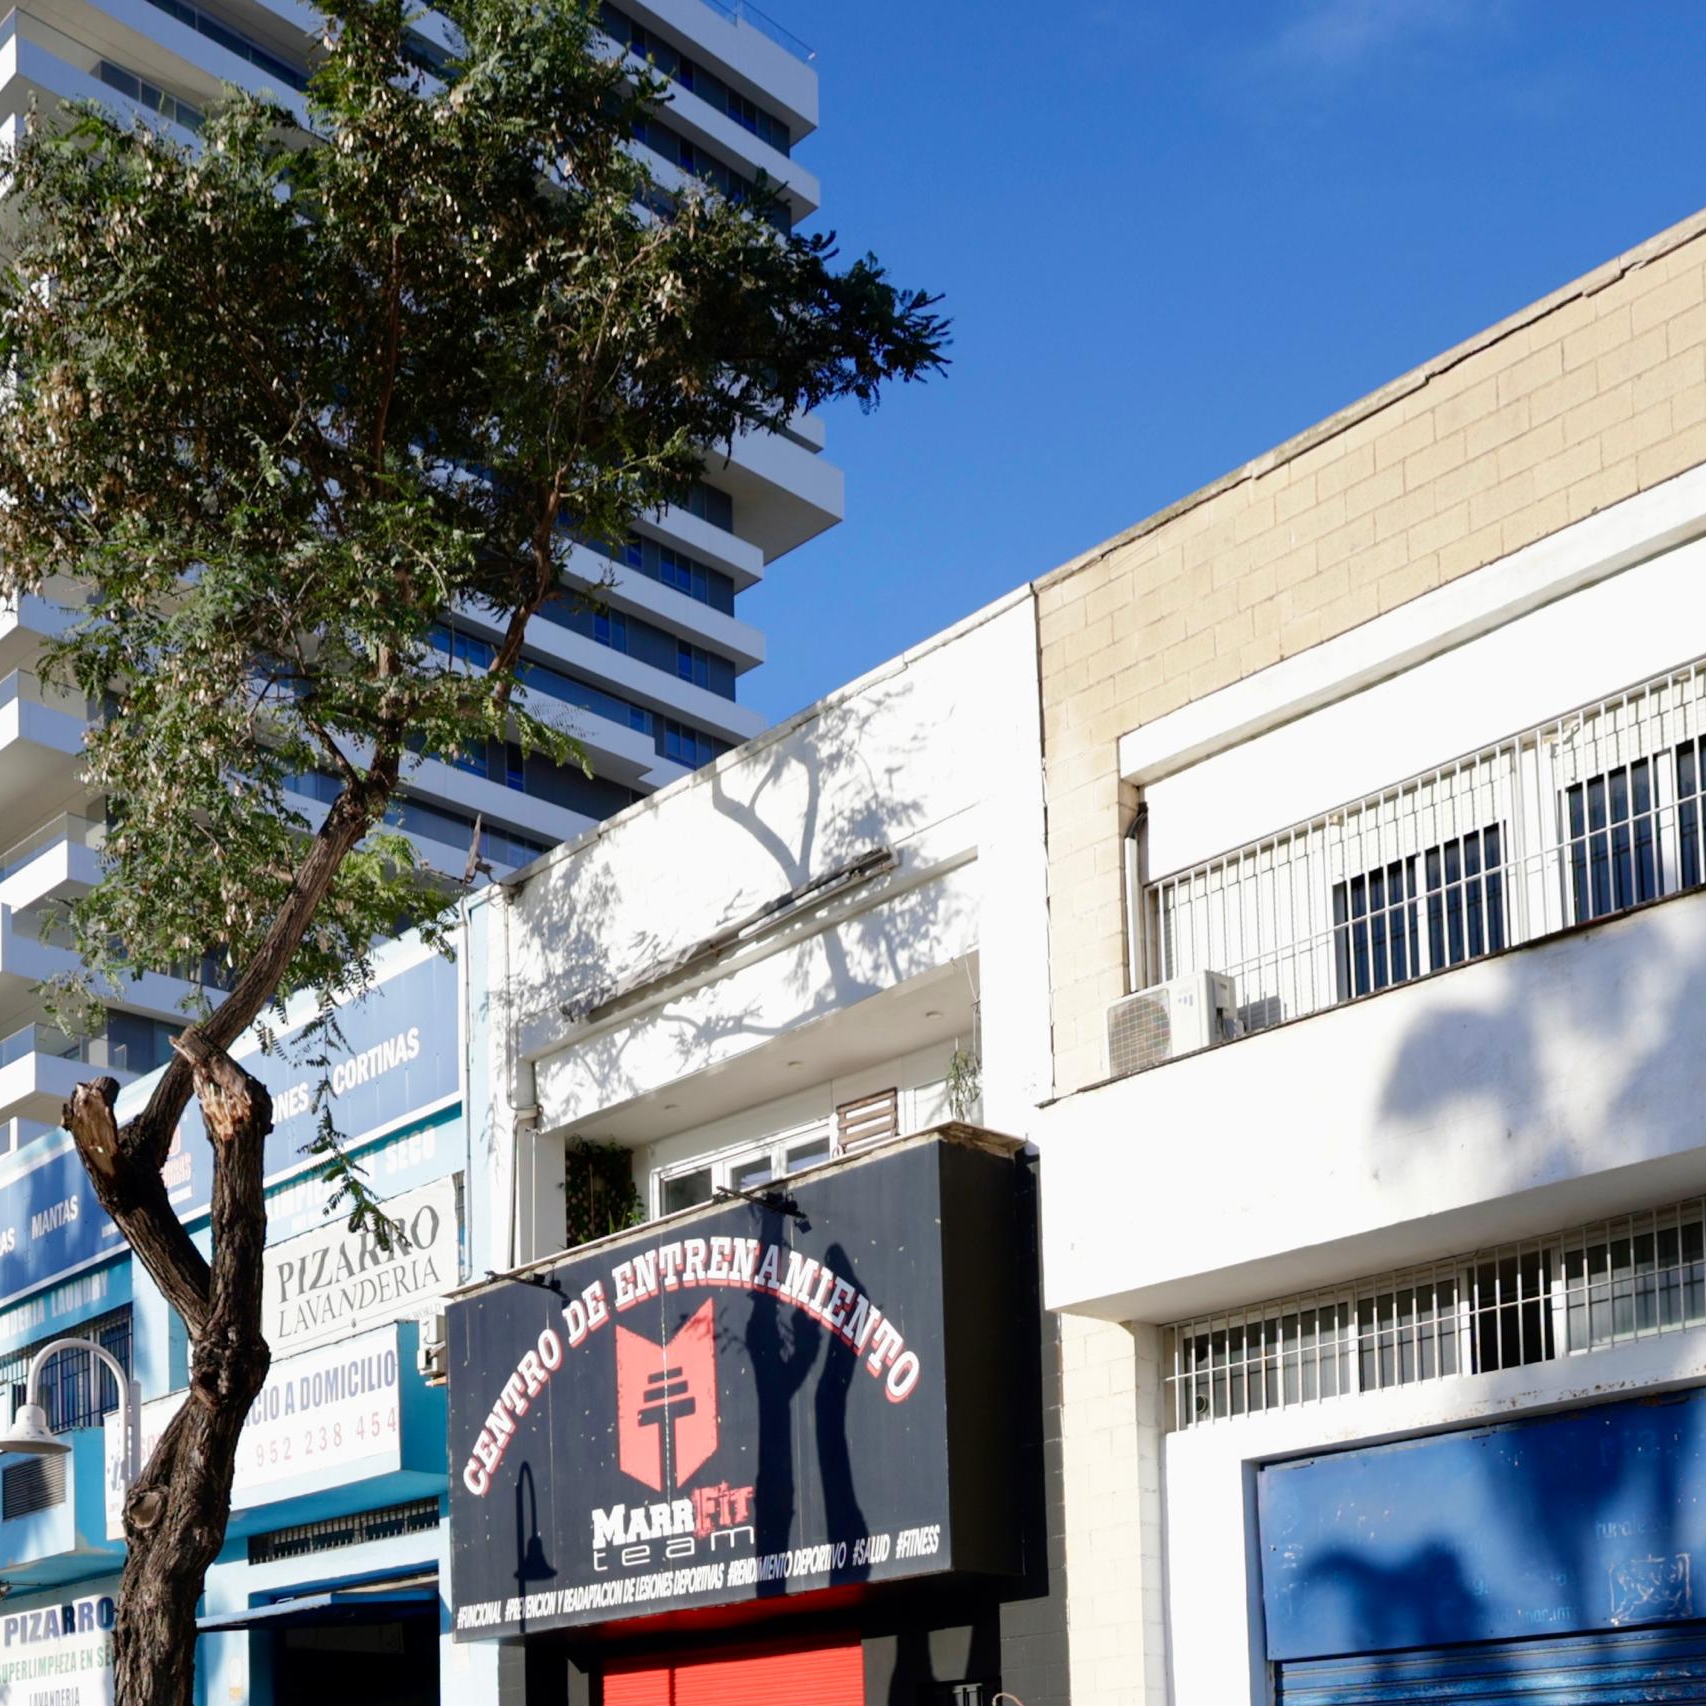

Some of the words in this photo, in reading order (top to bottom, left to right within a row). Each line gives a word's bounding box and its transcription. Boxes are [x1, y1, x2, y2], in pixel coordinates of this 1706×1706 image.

[332, 1027, 420, 1096] CORTINAS
[31, 1195, 79, 1240] MANTAS
[277, 1204, 440, 1304] PIZARRO
[51, 1270, 109, 1319] LAUNDRY
[278, 1255, 441, 1338] LAVANDERIA
[284, 1380, 295, 1416] A
[300, 1349, 397, 1412] DOMICILIO
[462, 1328, 564, 1497] CENTRO
[561, 1278, 611, 1348] DE
[610, 1235, 923, 1403] ENTRENAMIENTO
[255, 1436, 292, 1468] 952
[305, 1421, 342, 1455] 238
[356, 1407, 397, 1441] 454
[456, 1600, 502, 1630] #FUNCIONAL
[563, 1578, 623, 1614] READAPTACION
[622, 1576, 636, 1604] DE
[635, 1570, 673, 1602] LESIONES
[672, 1562, 725, 1595] DEPORTIVAS
[727, 1549, 792, 1587] #RENDIMIENTO
[792, 1541, 847, 1577] DEPORTIVO
[852, 1533, 891, 1567] #SALUD
[895, 1524, 941, 1559] #FITNESS
[594, 1526, 755, 1571] team
[4, 1596, 115, 1647] PIZARRO
[80, 1647, 94, 1671] EN
